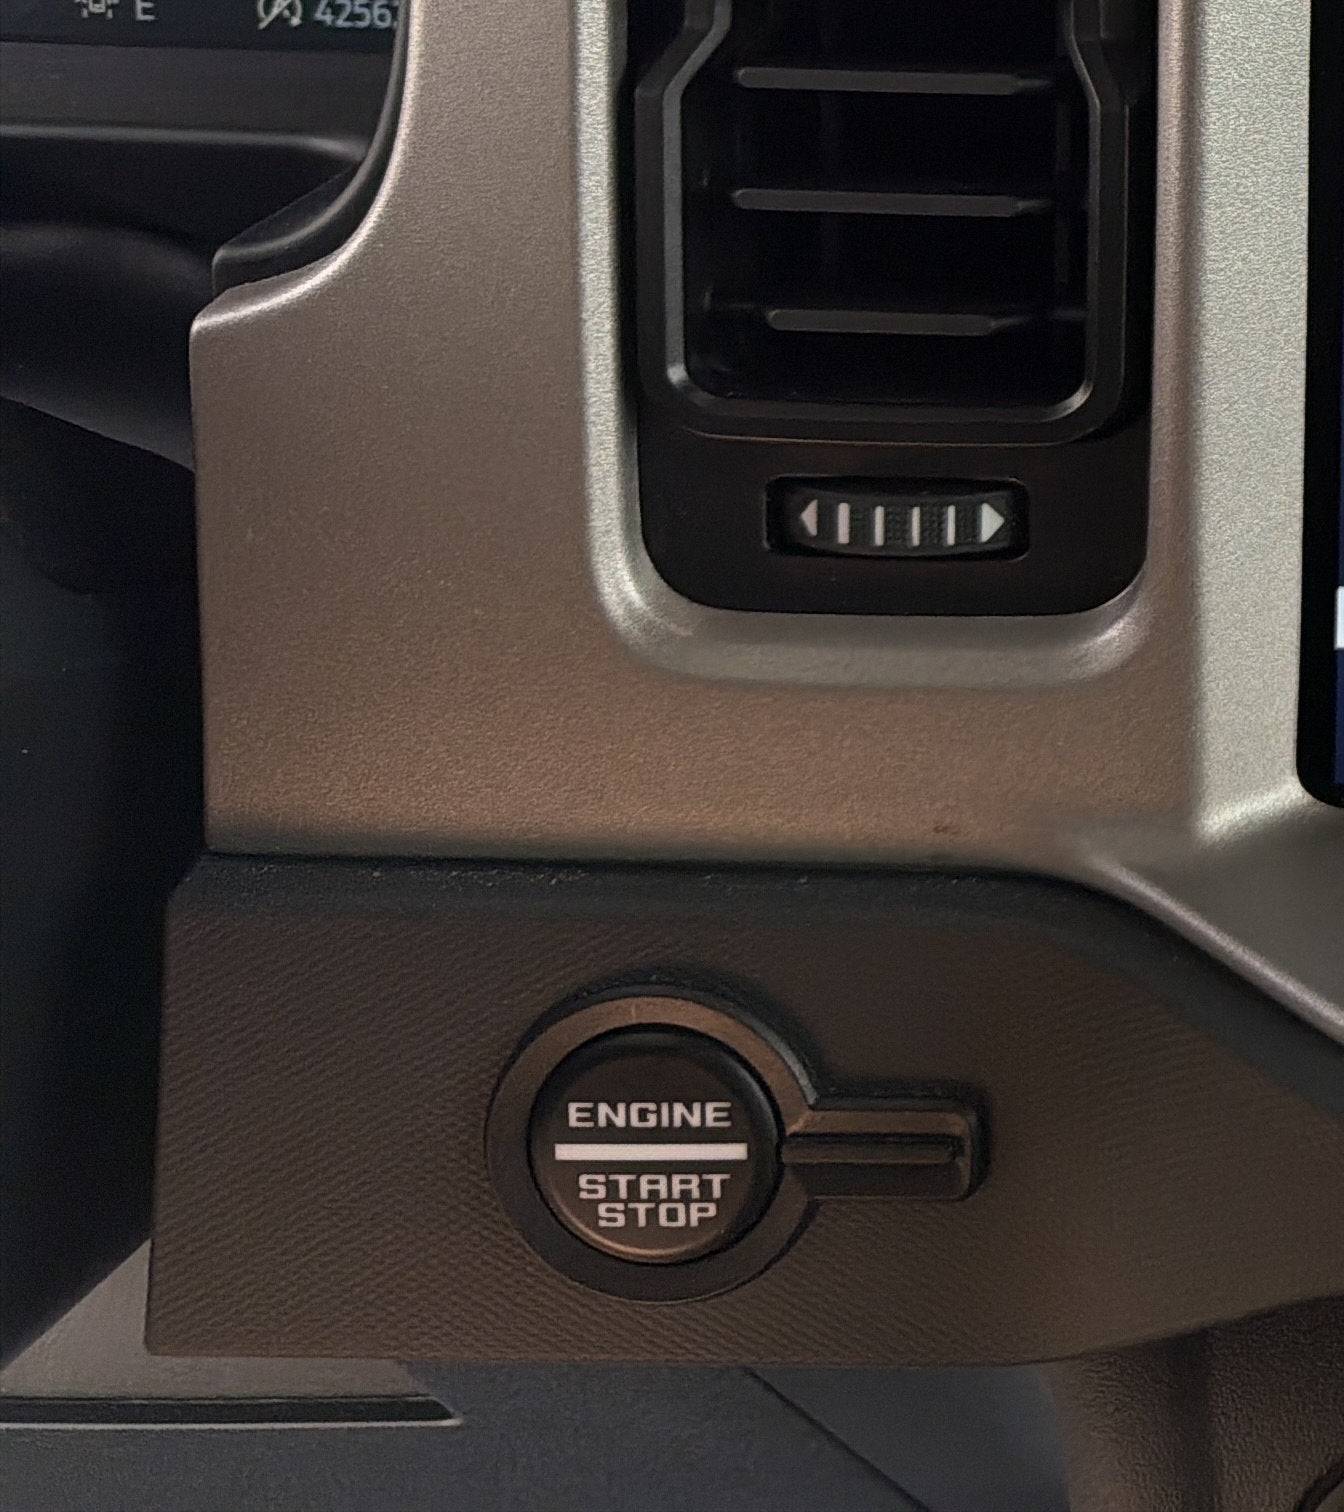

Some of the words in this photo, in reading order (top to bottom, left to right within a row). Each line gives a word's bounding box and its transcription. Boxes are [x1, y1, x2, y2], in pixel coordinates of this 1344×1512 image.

[567, 1101, 732, 1128] ENGINE
[578, 1173, 731, 1200] START
[598, 1202, 717, 1227] STOP
